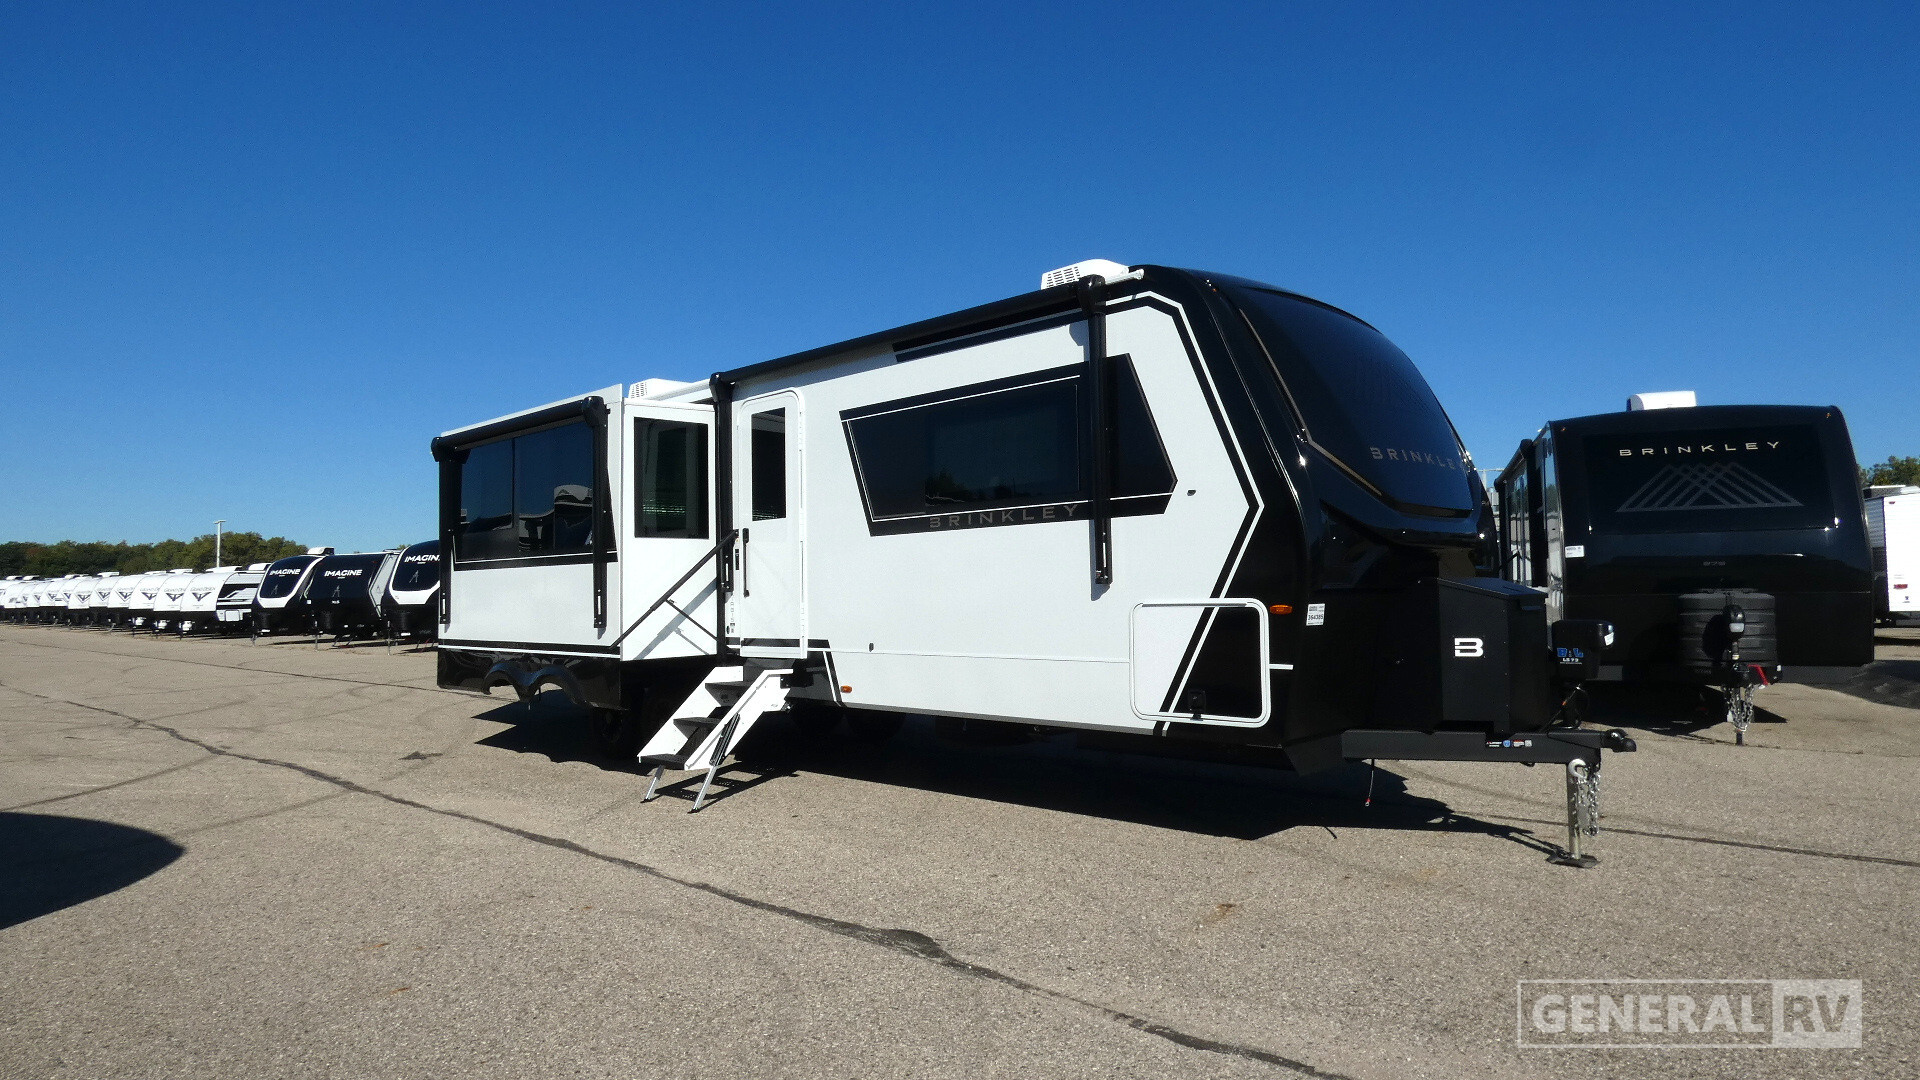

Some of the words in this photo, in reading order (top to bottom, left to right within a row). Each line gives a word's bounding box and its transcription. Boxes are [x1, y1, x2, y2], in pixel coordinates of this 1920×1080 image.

[1619, 440, 1780, 457] BRINKLEY
[929, 503, 1079, 529] BRINKLEY
[269, 568, 301, 576] IMAGINE
[324, 569, 363, 577] IMAGINE
[1454, 637, 1484, 658] B
